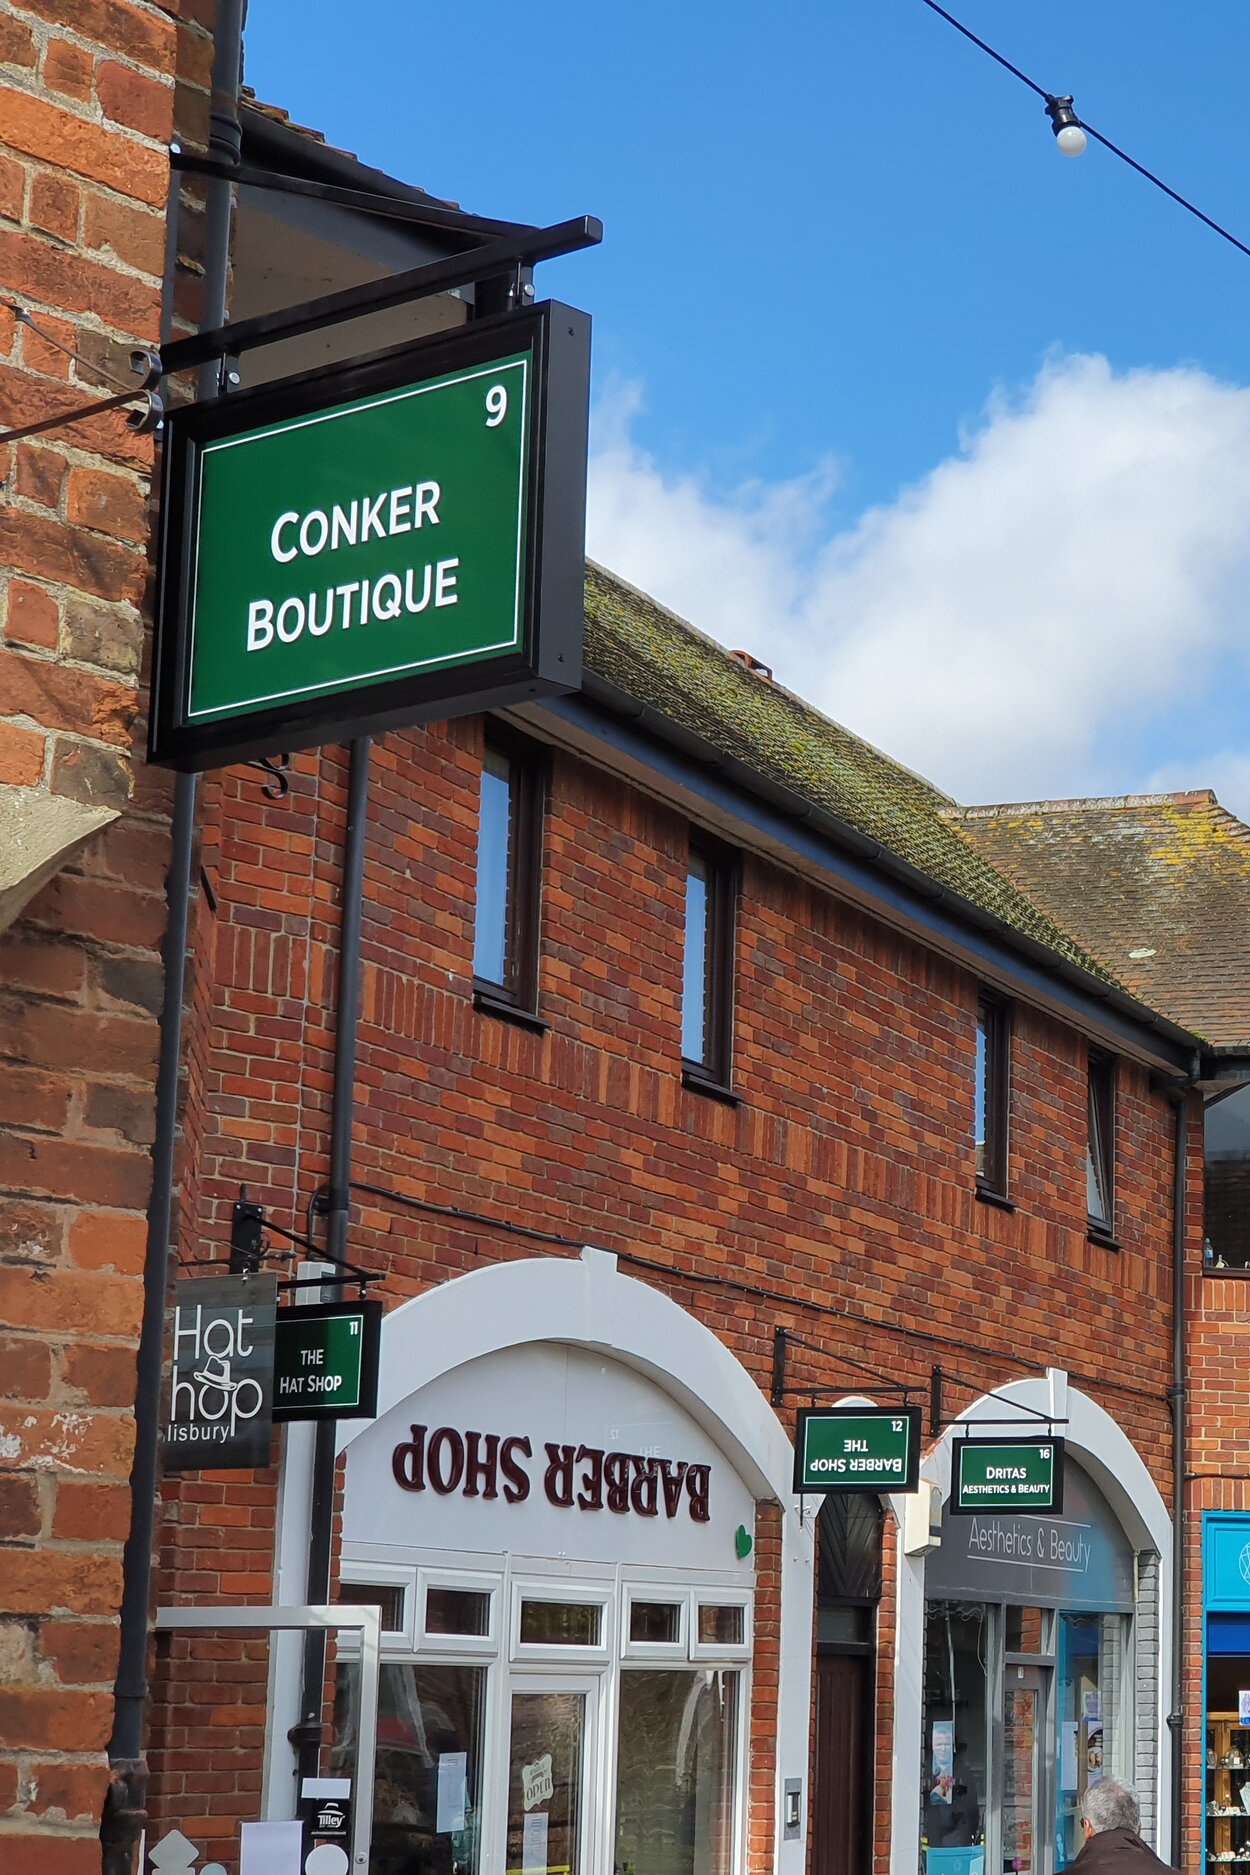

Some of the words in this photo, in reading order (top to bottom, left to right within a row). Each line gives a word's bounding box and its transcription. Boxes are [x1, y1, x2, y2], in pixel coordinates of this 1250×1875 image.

[485, 384, 507, 428] 9
[270, 480, 441, 563] CONKER
[246, 557, 460, 652] BOUTIQUE
[174, 1304, 254, 1361] Hat
[349, 1321, 359, 1336] 11
[300, 1349, 325, 1365] THE
[279, 1376, 305, 1394] HAT
[307, 1374, 343, 1392] SHOP
[171, 1365, 263, 1437] hop
[163, 1423, 230, 1444] lisbury
[891, 1420, 903, 1432] 12
[843, 1440, 869, 1452] THE
[1039, 1448, 1050, 1459] 16
[392, 1424, 533, 1504] SHOP
[810, 1459, 847, 1472] SHOP
[849, 1459, 903, 1472] BARBER
[985, 1466, 1027, 1479] DRITAS
[544, 1442, 712, 1523] BARBER
[962, 1484, 1009, 1494] AESTHETICS
[1010, 1485, 1017, 1494] &
[1018, 1484, 1050, 1494] BEAUTY
[968, 1517, 1032, 1557] Aesthetics
[1036, 1527, 1045, 1559] &
[1050, 1529, 1091, 1573] Beauty
[317, 1815, 346, 1828] Tilley
